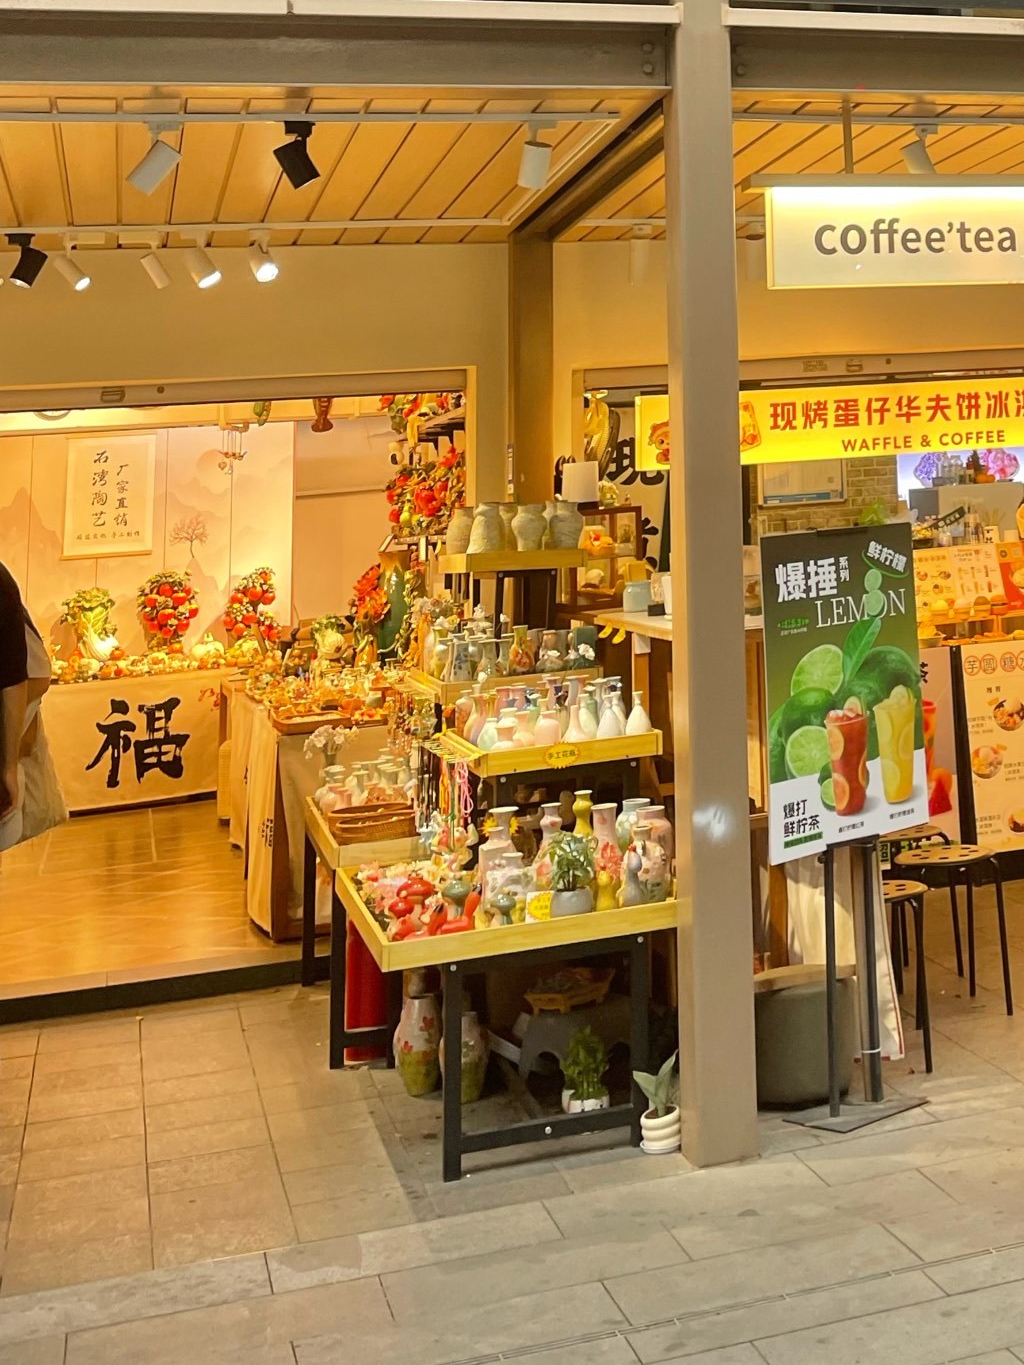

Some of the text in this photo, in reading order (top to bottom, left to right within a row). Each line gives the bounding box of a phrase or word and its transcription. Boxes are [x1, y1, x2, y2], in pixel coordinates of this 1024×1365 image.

[842, 430, 1006, 452] WAFFLE & COFFEE
[113, 464, 129, 526] 厂家直销
[839, 556, 850, 582] 系列
[867, 540, 907, 573] 鲜柠檬
[86, 697, 190, 788] 福
[783, 799, 808, 820] 爆打
[783, 814, 820, 839] 鲜柠茶
